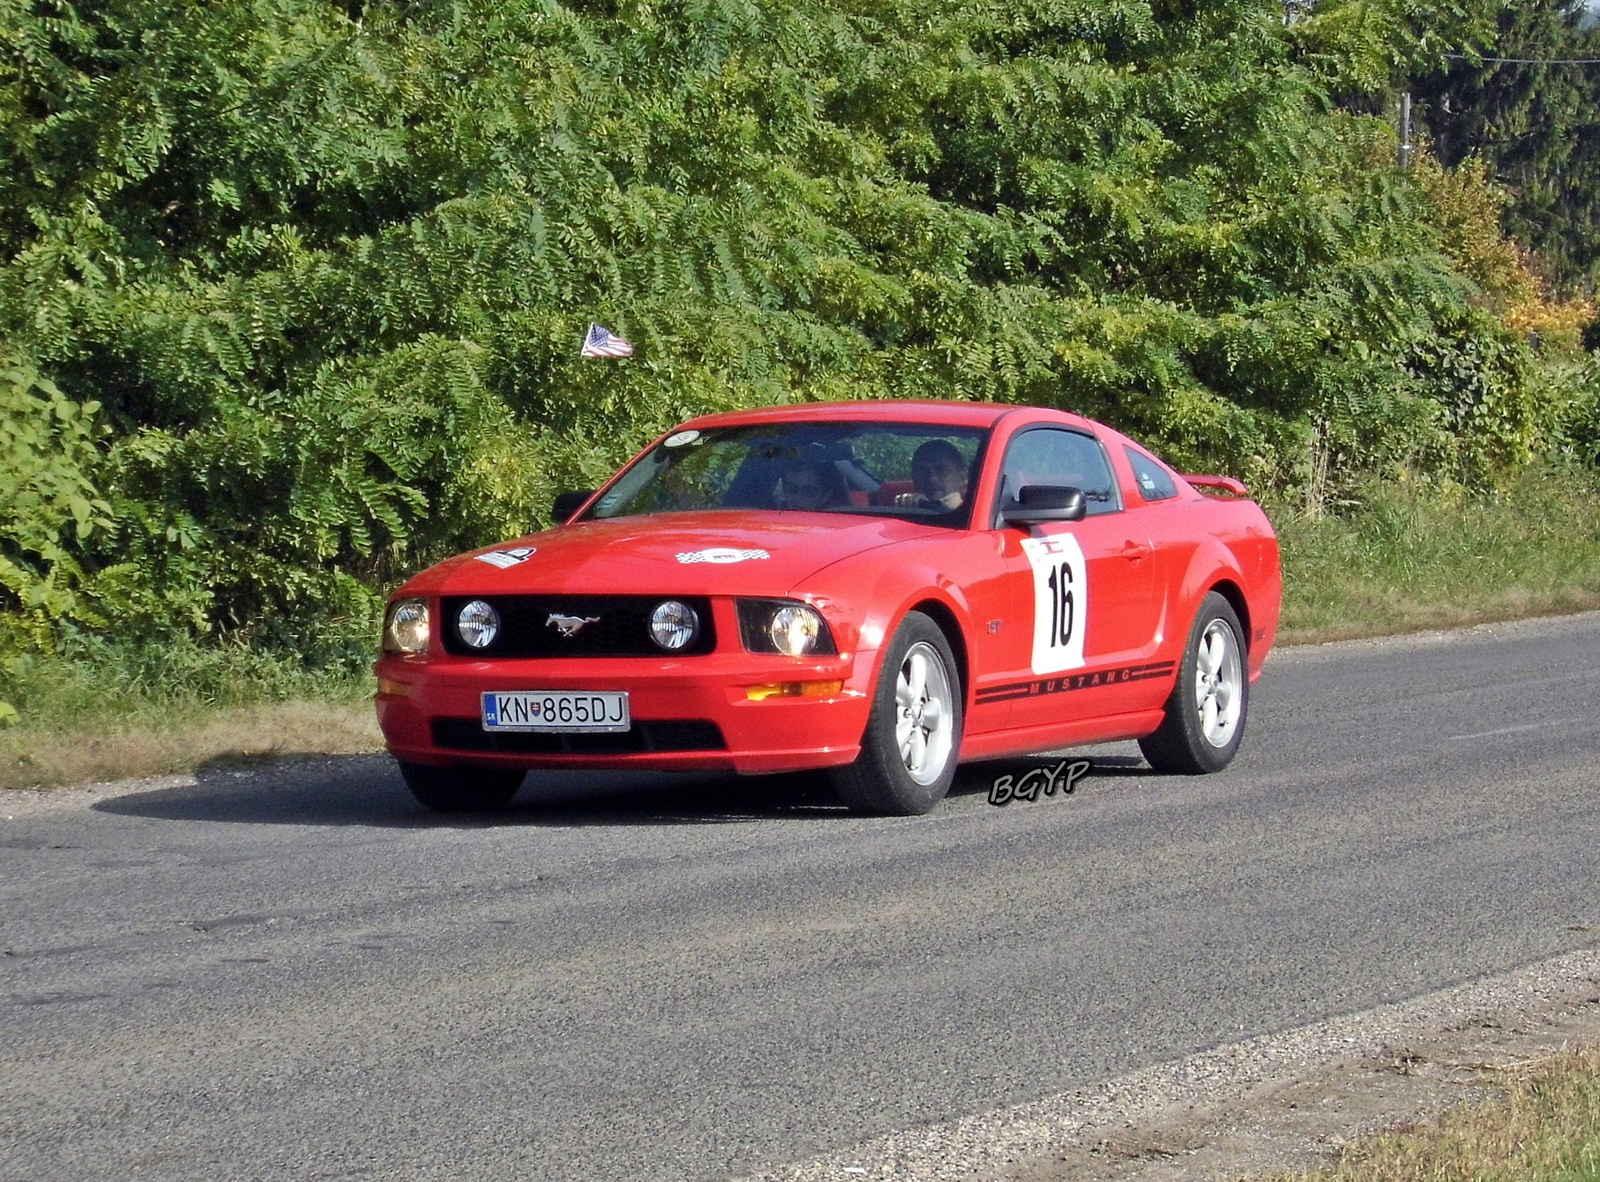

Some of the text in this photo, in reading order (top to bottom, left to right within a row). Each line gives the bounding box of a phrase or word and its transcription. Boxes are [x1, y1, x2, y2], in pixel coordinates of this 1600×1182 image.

[1048, 561, 1074, 648] 16
[1030, 670, 1130, 694] MUSTANG
[498, 696, 624, 723] KN 865DJ
